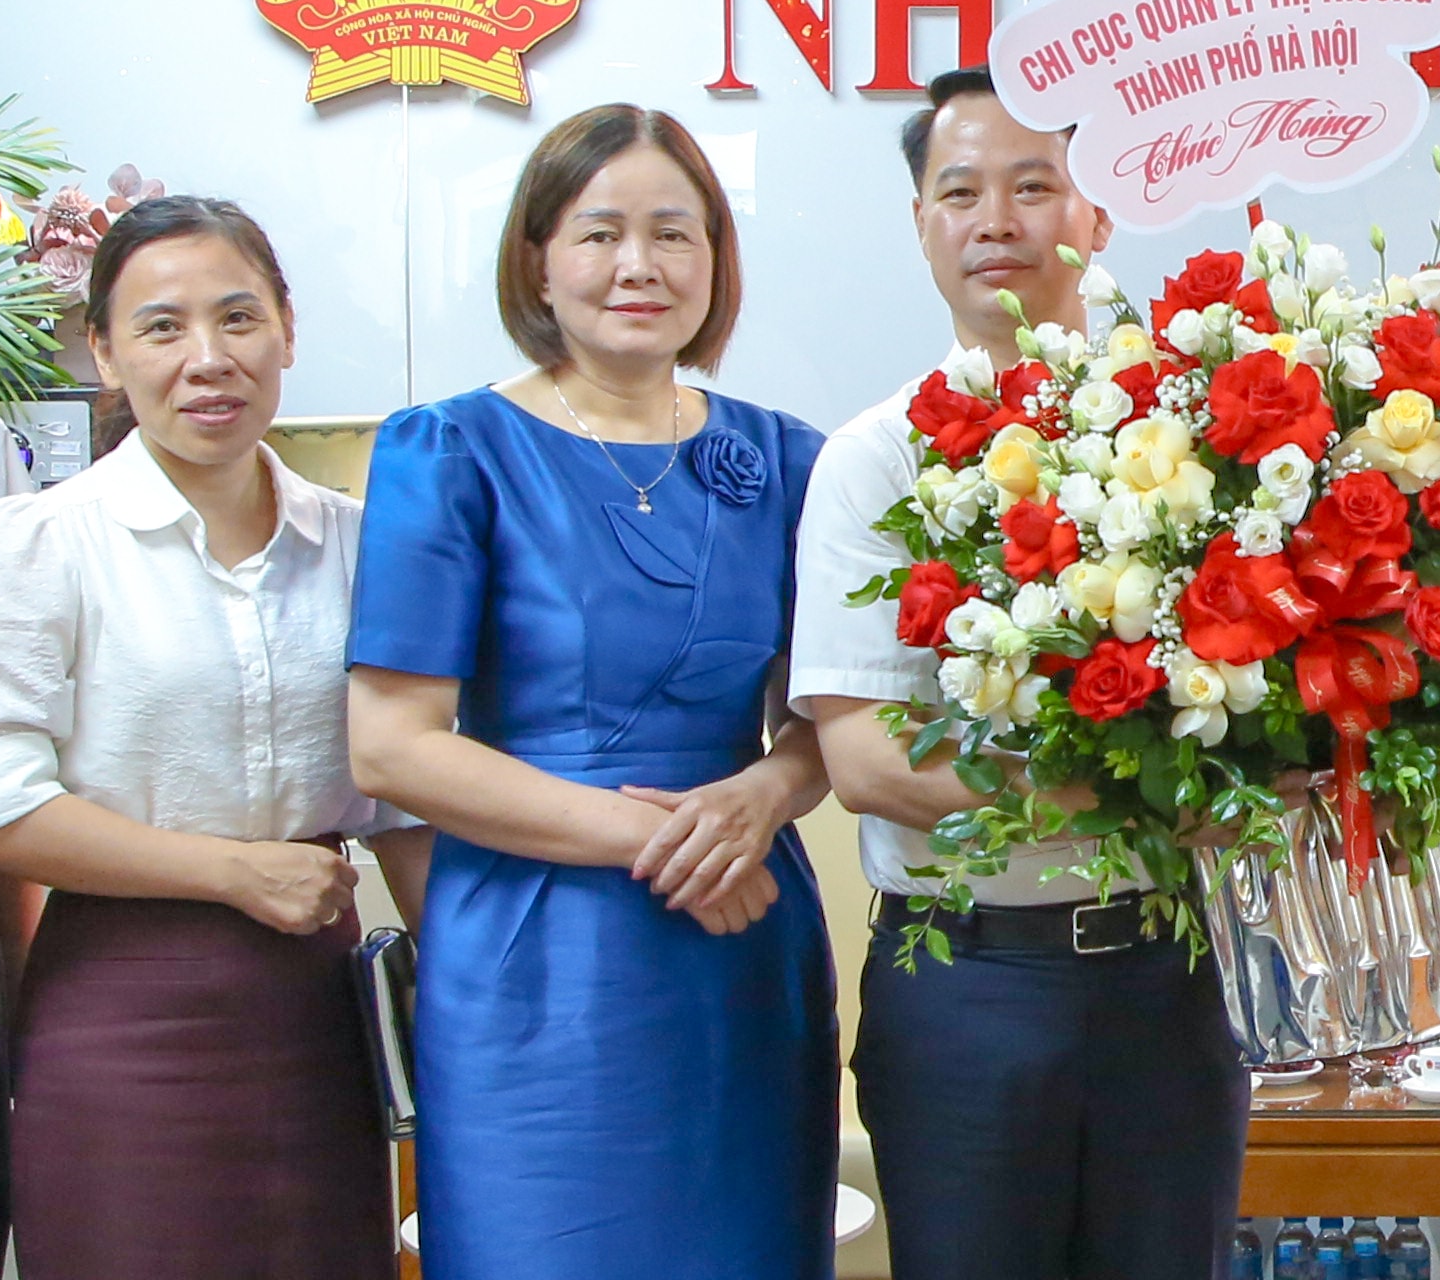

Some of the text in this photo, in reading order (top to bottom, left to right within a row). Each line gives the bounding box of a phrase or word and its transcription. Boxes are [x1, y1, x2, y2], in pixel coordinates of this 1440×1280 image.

[334, 18, 366, 37] CỘNG
[362, 21, 470, 47] VIỆT NAM
[1019, 39, 1073, 93] CHI
[1071, 11, 1134, 67] CỤC
[1113, 19, 1359, 116] THÀNH PHỐ HÀ NỘI
[1113, 119, 1227, 204] Chúc
